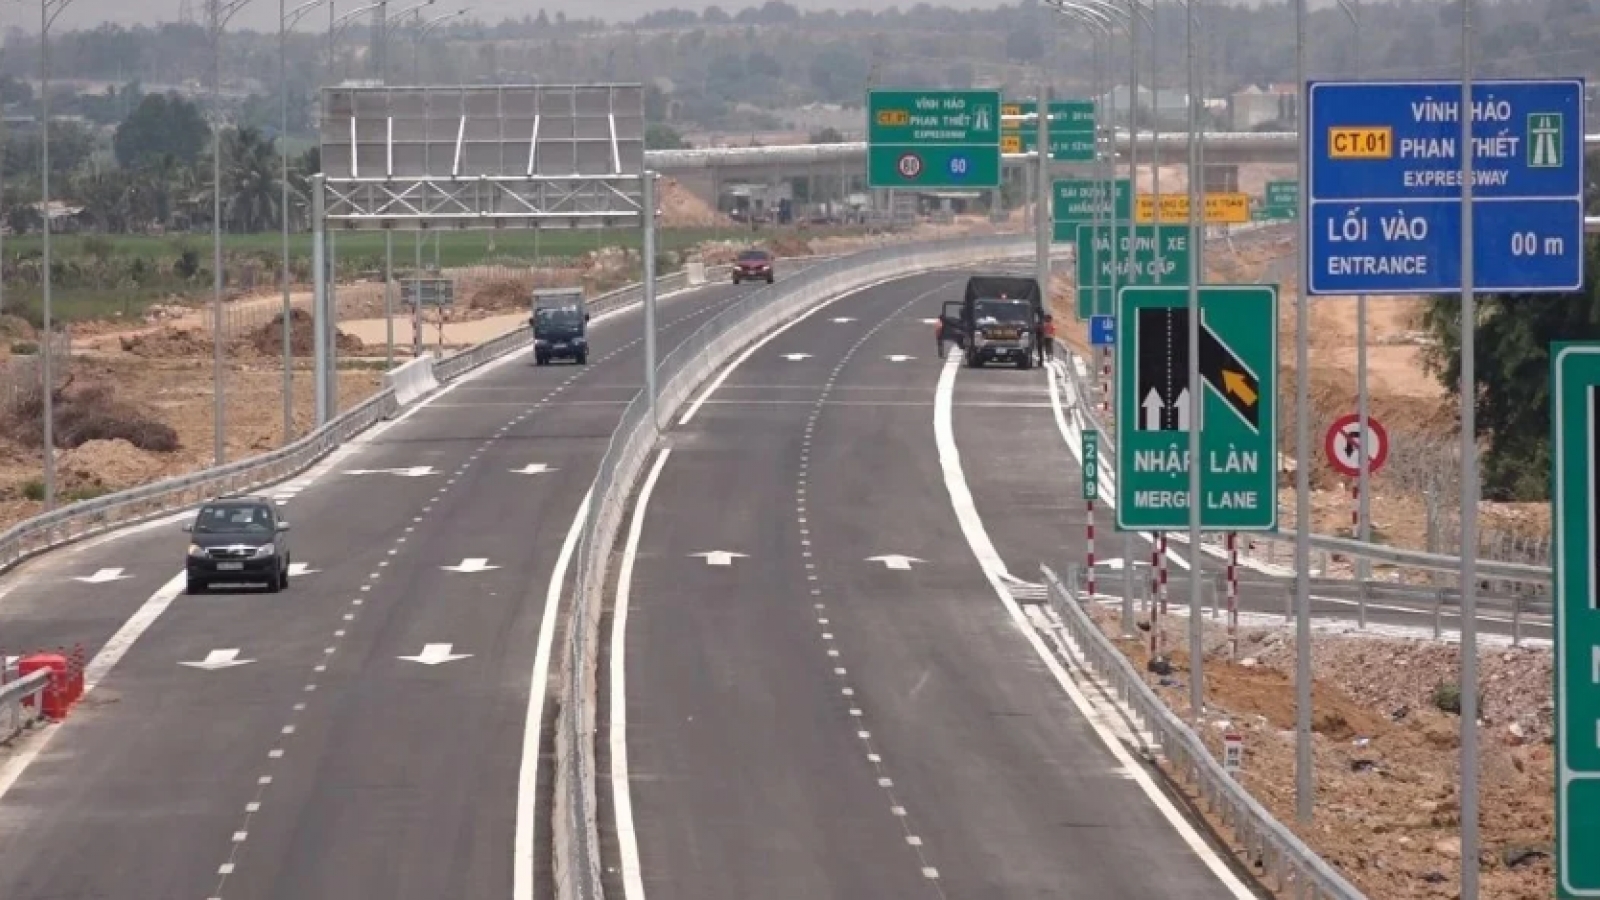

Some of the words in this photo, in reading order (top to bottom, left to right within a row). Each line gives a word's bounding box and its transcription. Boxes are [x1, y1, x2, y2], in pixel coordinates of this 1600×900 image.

[1411, 96, 1458, 122] VĨNH
[1471, 94, 1511, 121] HẢO
[1334, 133, 1387, 152] CT.01
[1400, 138, 1455, 158] PHAN
[1327, 207, 1368, 241] LỐI
[1381, 209, 1428, 241] VÀO
[1167, 236, 1186, 251] XE
[1511, 232, 1537, 255] 00
[1545, 237, 1564, 255] m
[1327, 257, 1427, 275] ENTRANCE
[1210, 442, 1258, 473] LÀN
[1134, 491, 1190, 509] MERG
[1207, 491, 1258, 509] LANE
